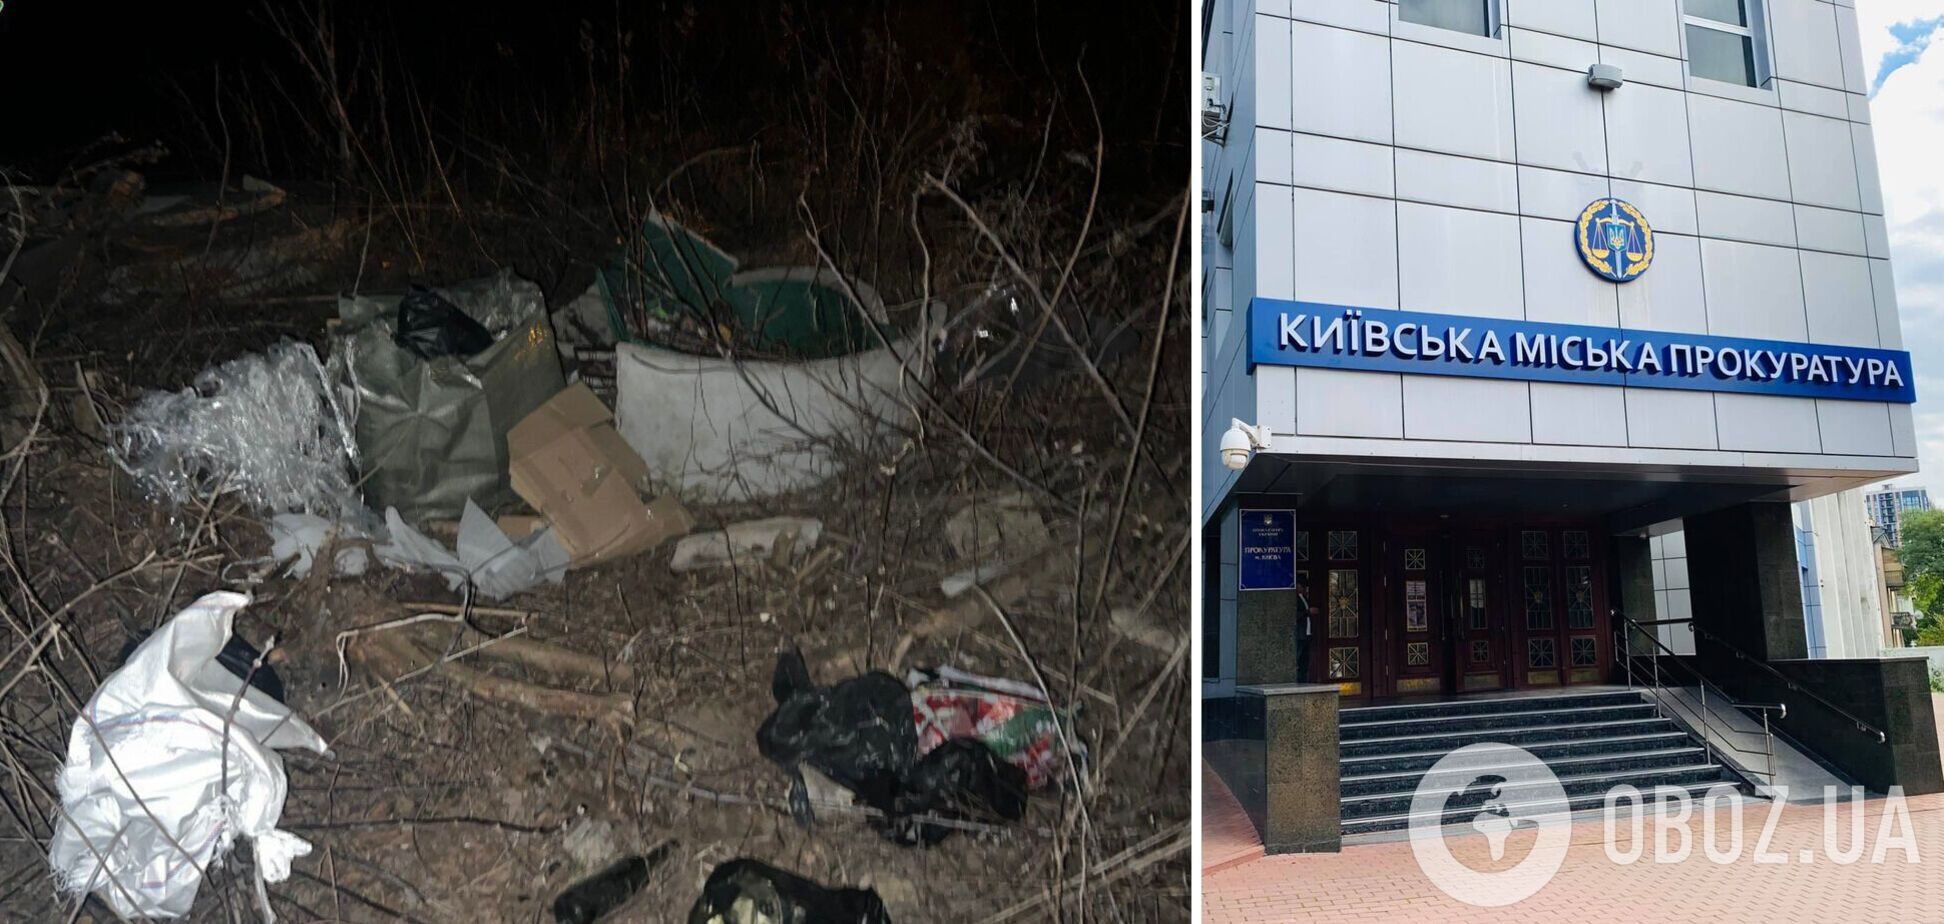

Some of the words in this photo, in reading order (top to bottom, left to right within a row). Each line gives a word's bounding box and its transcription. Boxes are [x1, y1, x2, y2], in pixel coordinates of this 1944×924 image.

[1279, 309, 1506, 362] КИЇВСЬКА
[1515, 331, 1662, 372] МІСЬКА
[1669, 343, 1905, 387] ПРОКУРАТУРА
